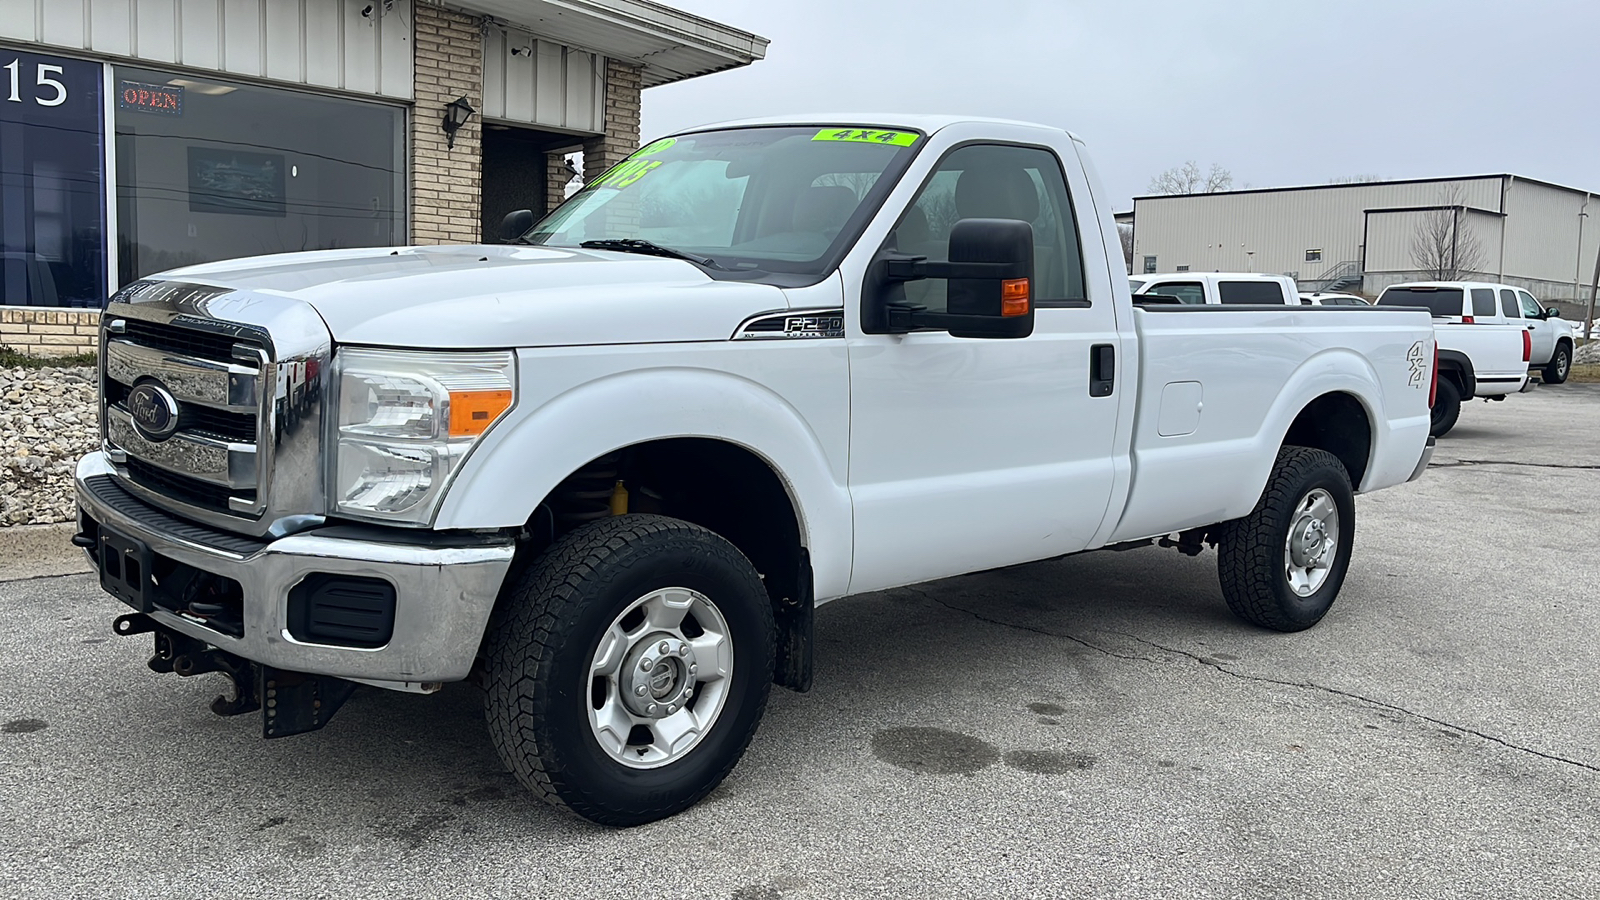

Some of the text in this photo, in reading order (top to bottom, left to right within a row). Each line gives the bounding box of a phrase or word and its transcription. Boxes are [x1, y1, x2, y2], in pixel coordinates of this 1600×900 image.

[3, 58, 68, 107] 15
[123, 88, 178, 110] OPEN
[132, 390, 159, 425] Ford
